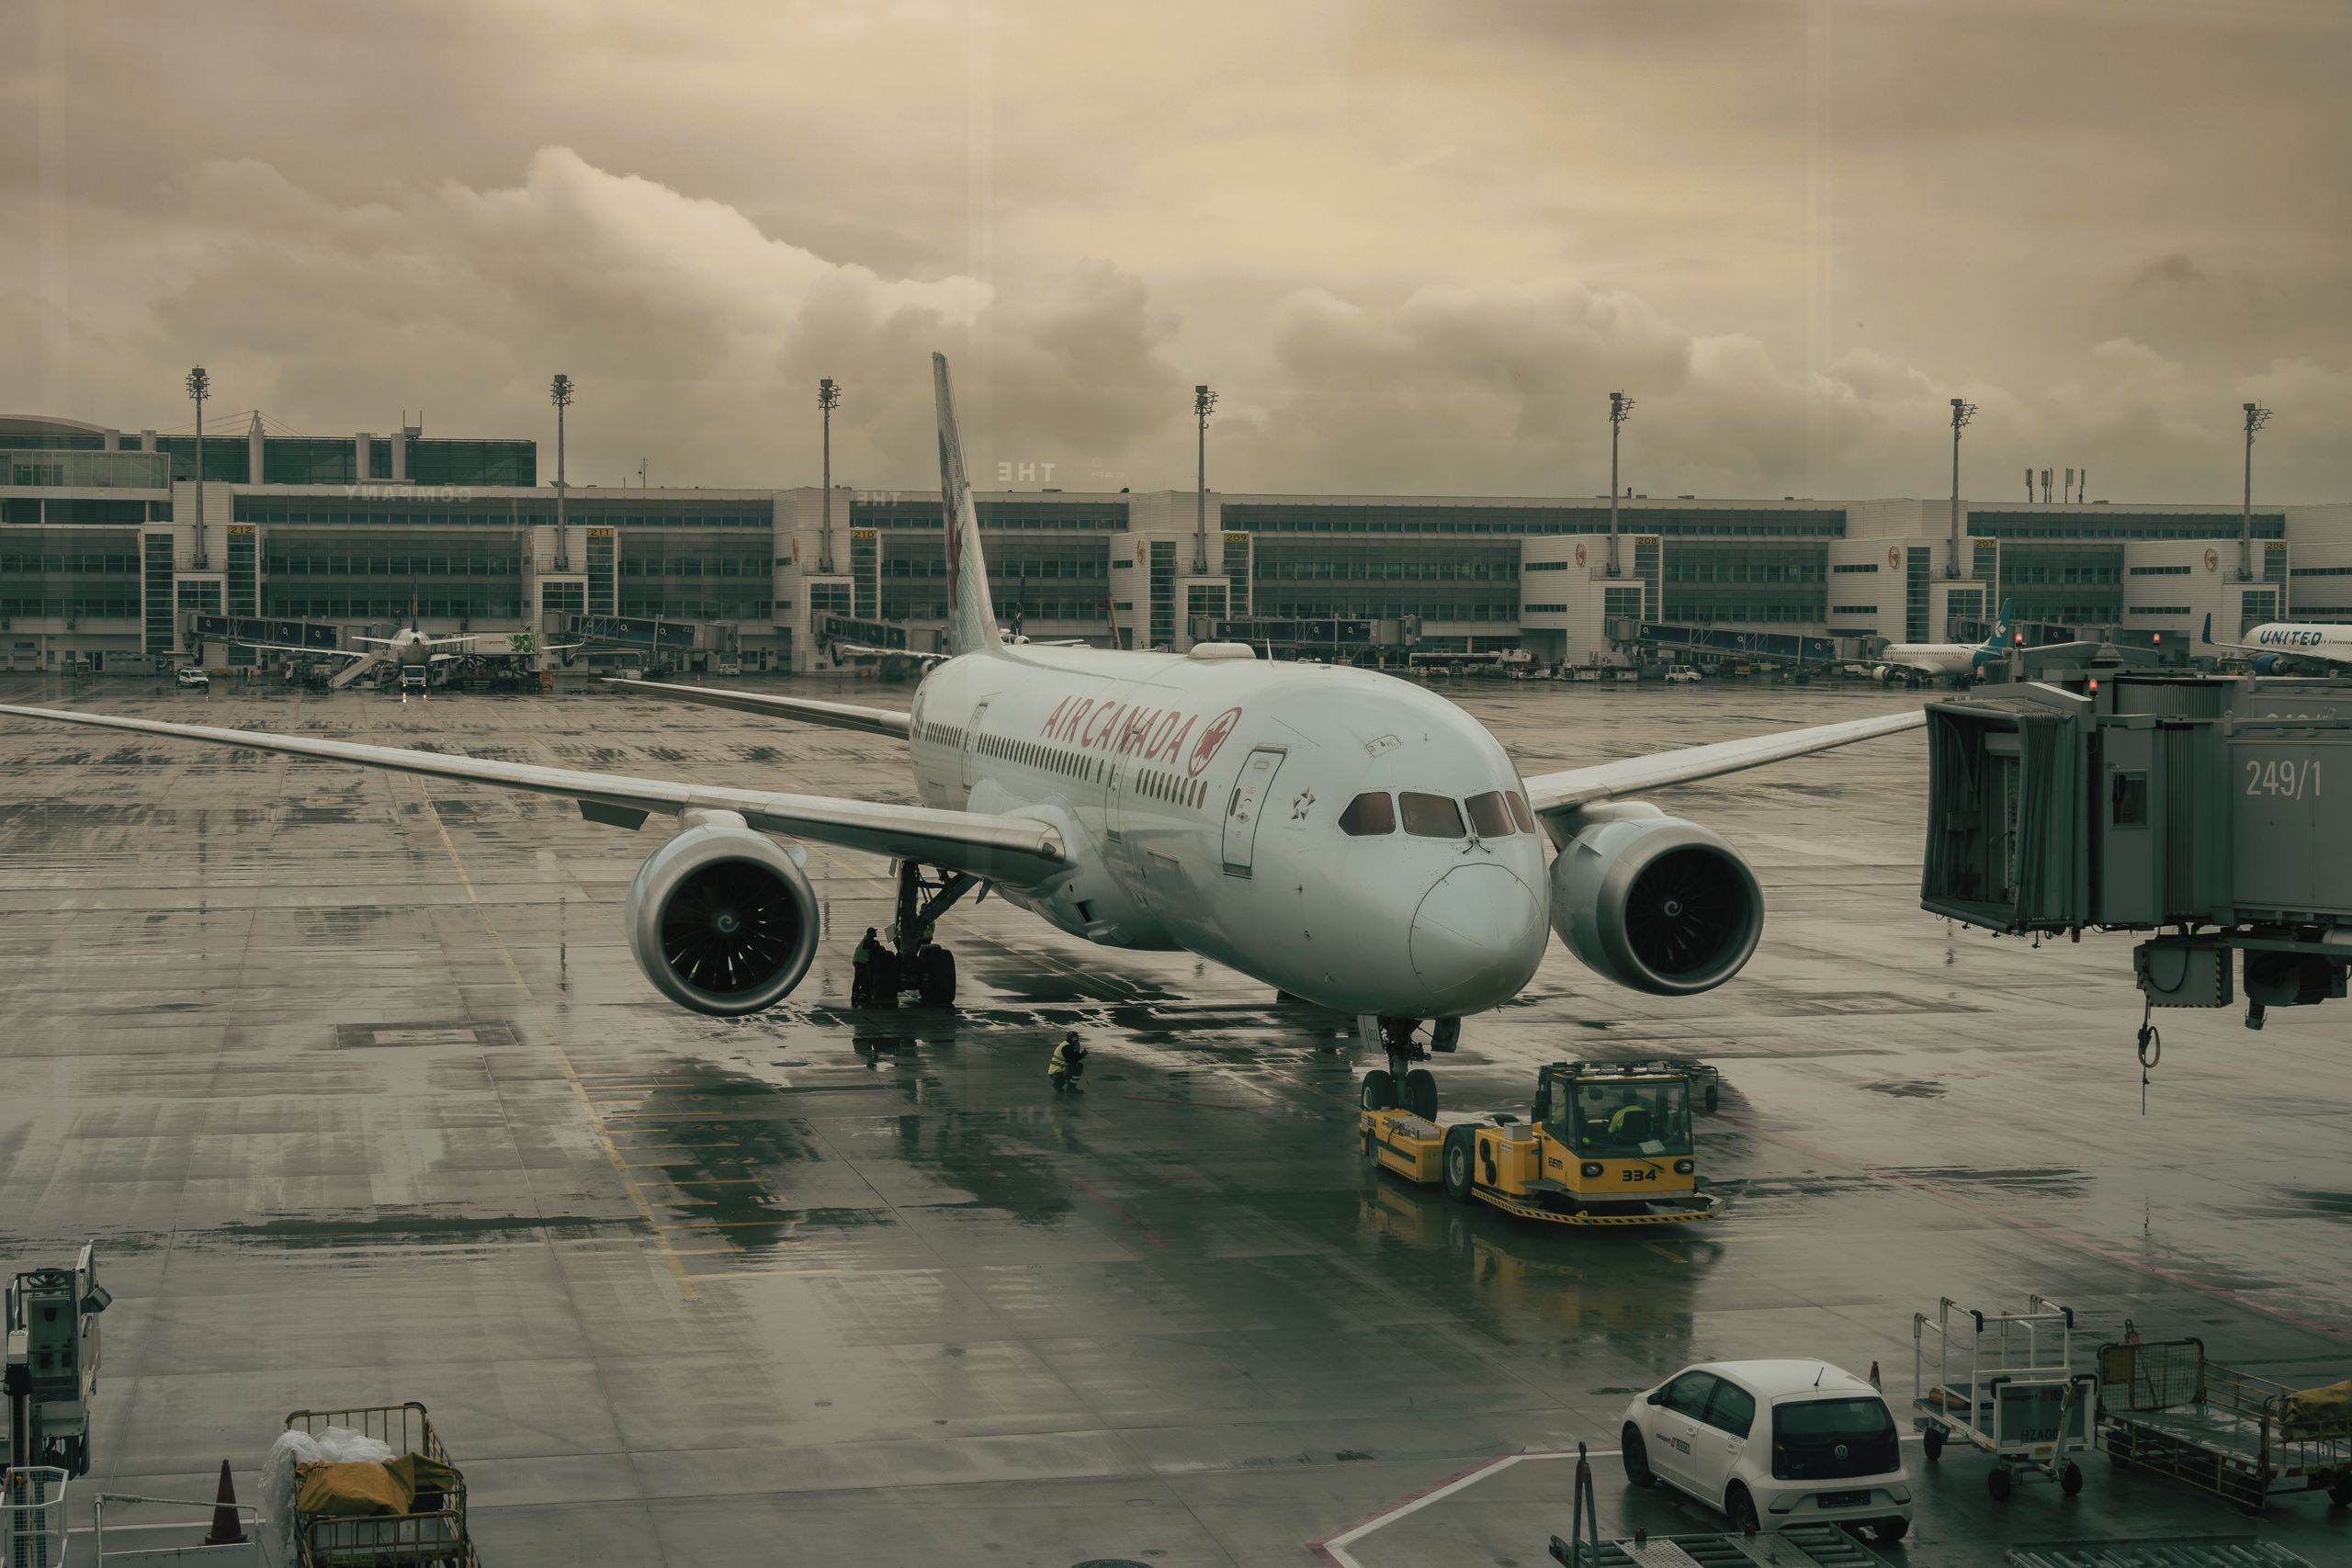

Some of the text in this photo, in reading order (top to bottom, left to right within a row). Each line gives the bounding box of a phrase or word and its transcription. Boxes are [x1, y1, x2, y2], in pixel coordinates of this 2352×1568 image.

[230, 526, 253, 535] 212
[1227, 534, 1247, 542] 209
[2260, 630, 2322, 646] UNITED
[1039, 695, 1199, 765] AIR CANADA
[2245, 759, 2321, 800] 249/1
[1623, 1169, 1657, 1181] 334
